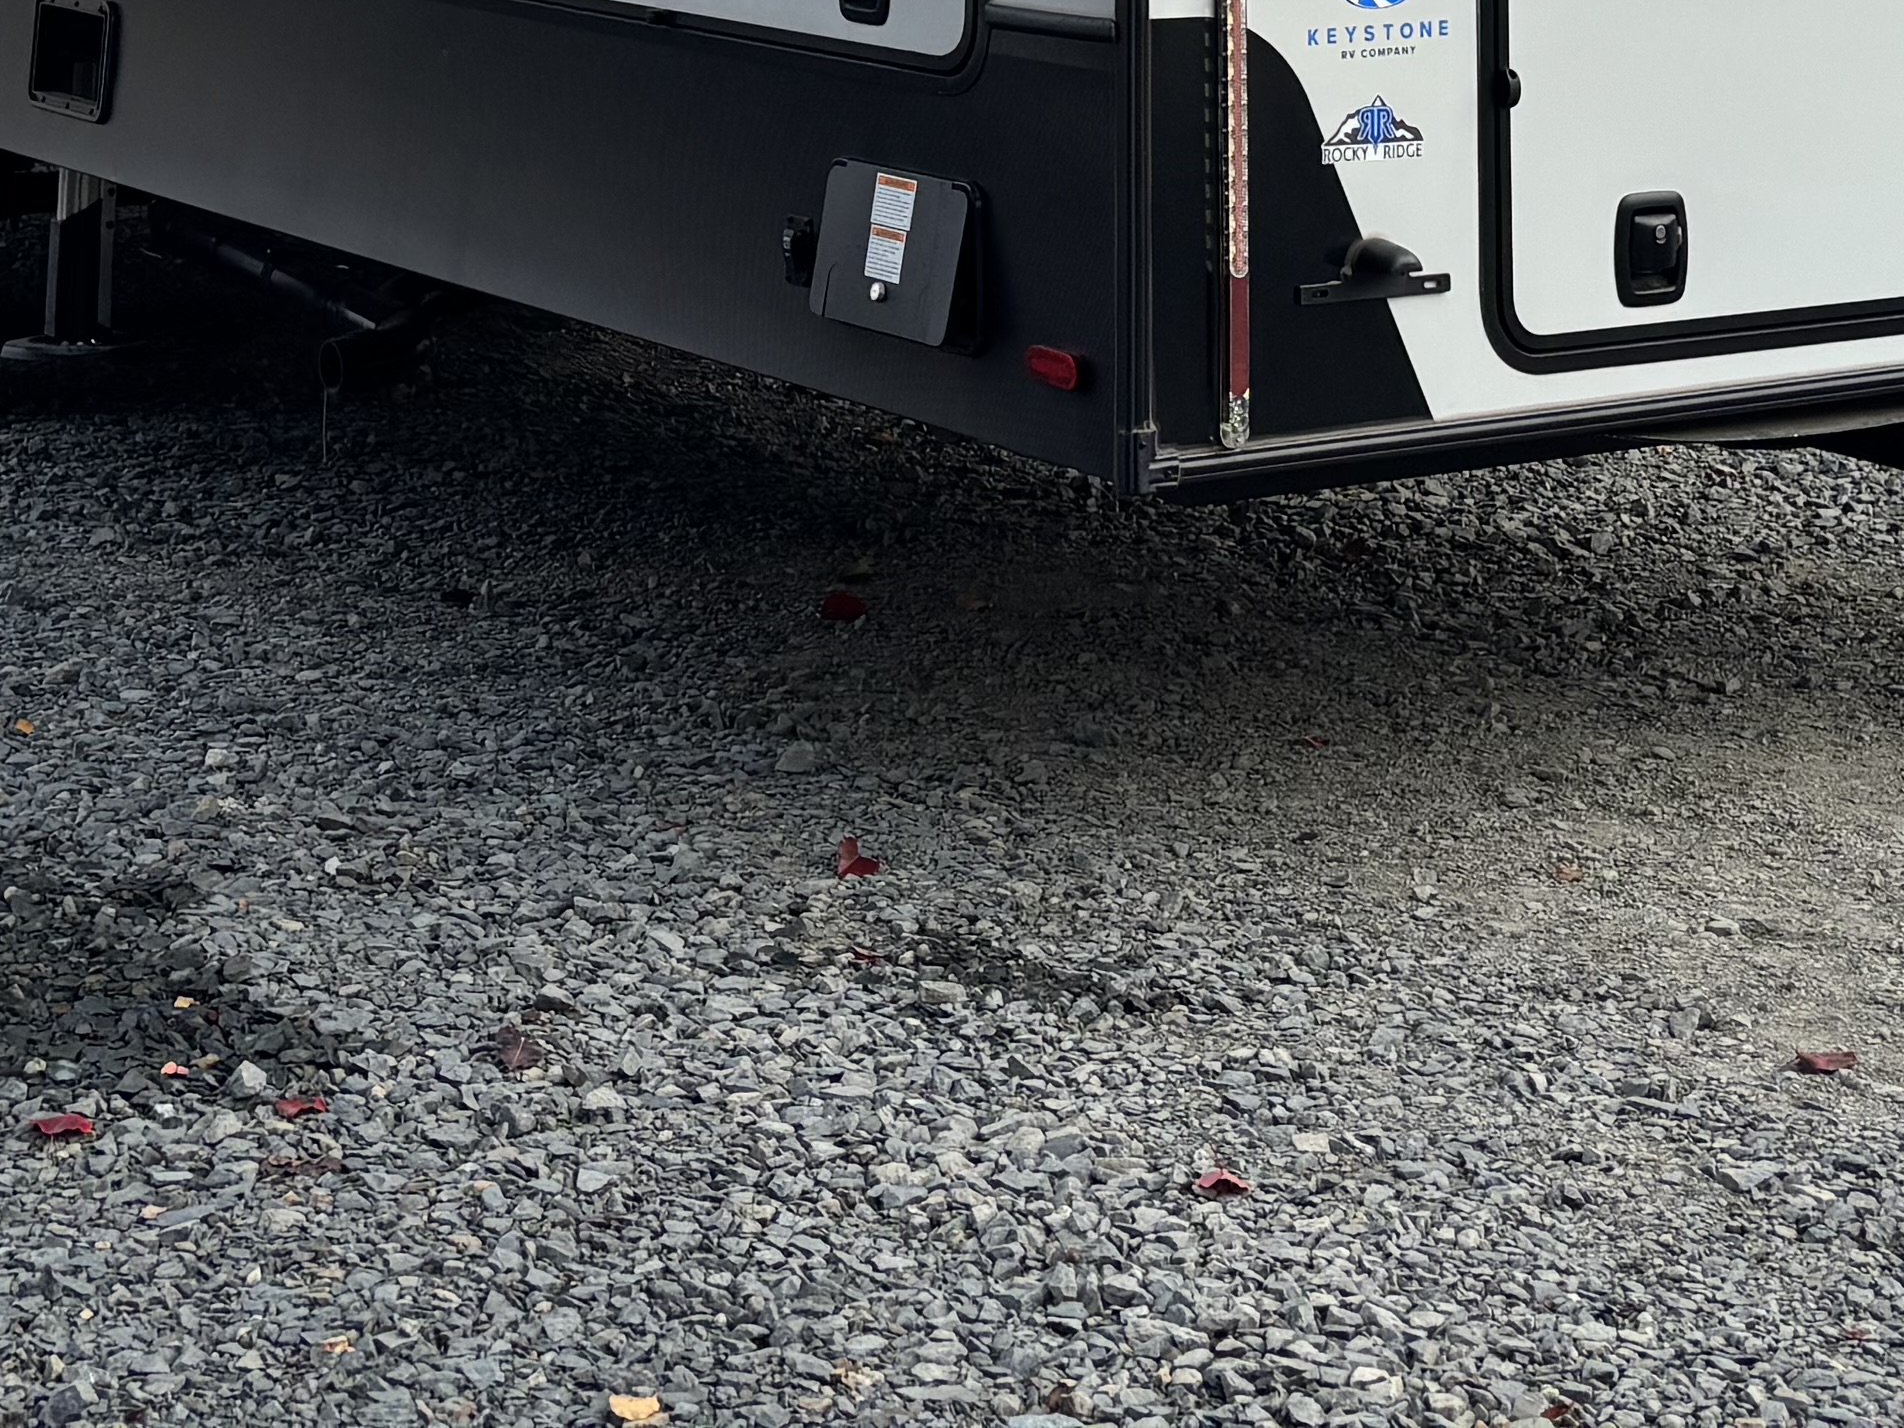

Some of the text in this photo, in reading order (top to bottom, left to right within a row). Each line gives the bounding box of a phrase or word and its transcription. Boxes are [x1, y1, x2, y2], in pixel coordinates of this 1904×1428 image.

[1307, 20, 1449, 46] KEYSTONE
[1341, 46, 1416, 60] RV COMPANY
[1324, 143, 1423, 162] ROCKY RIDGE
